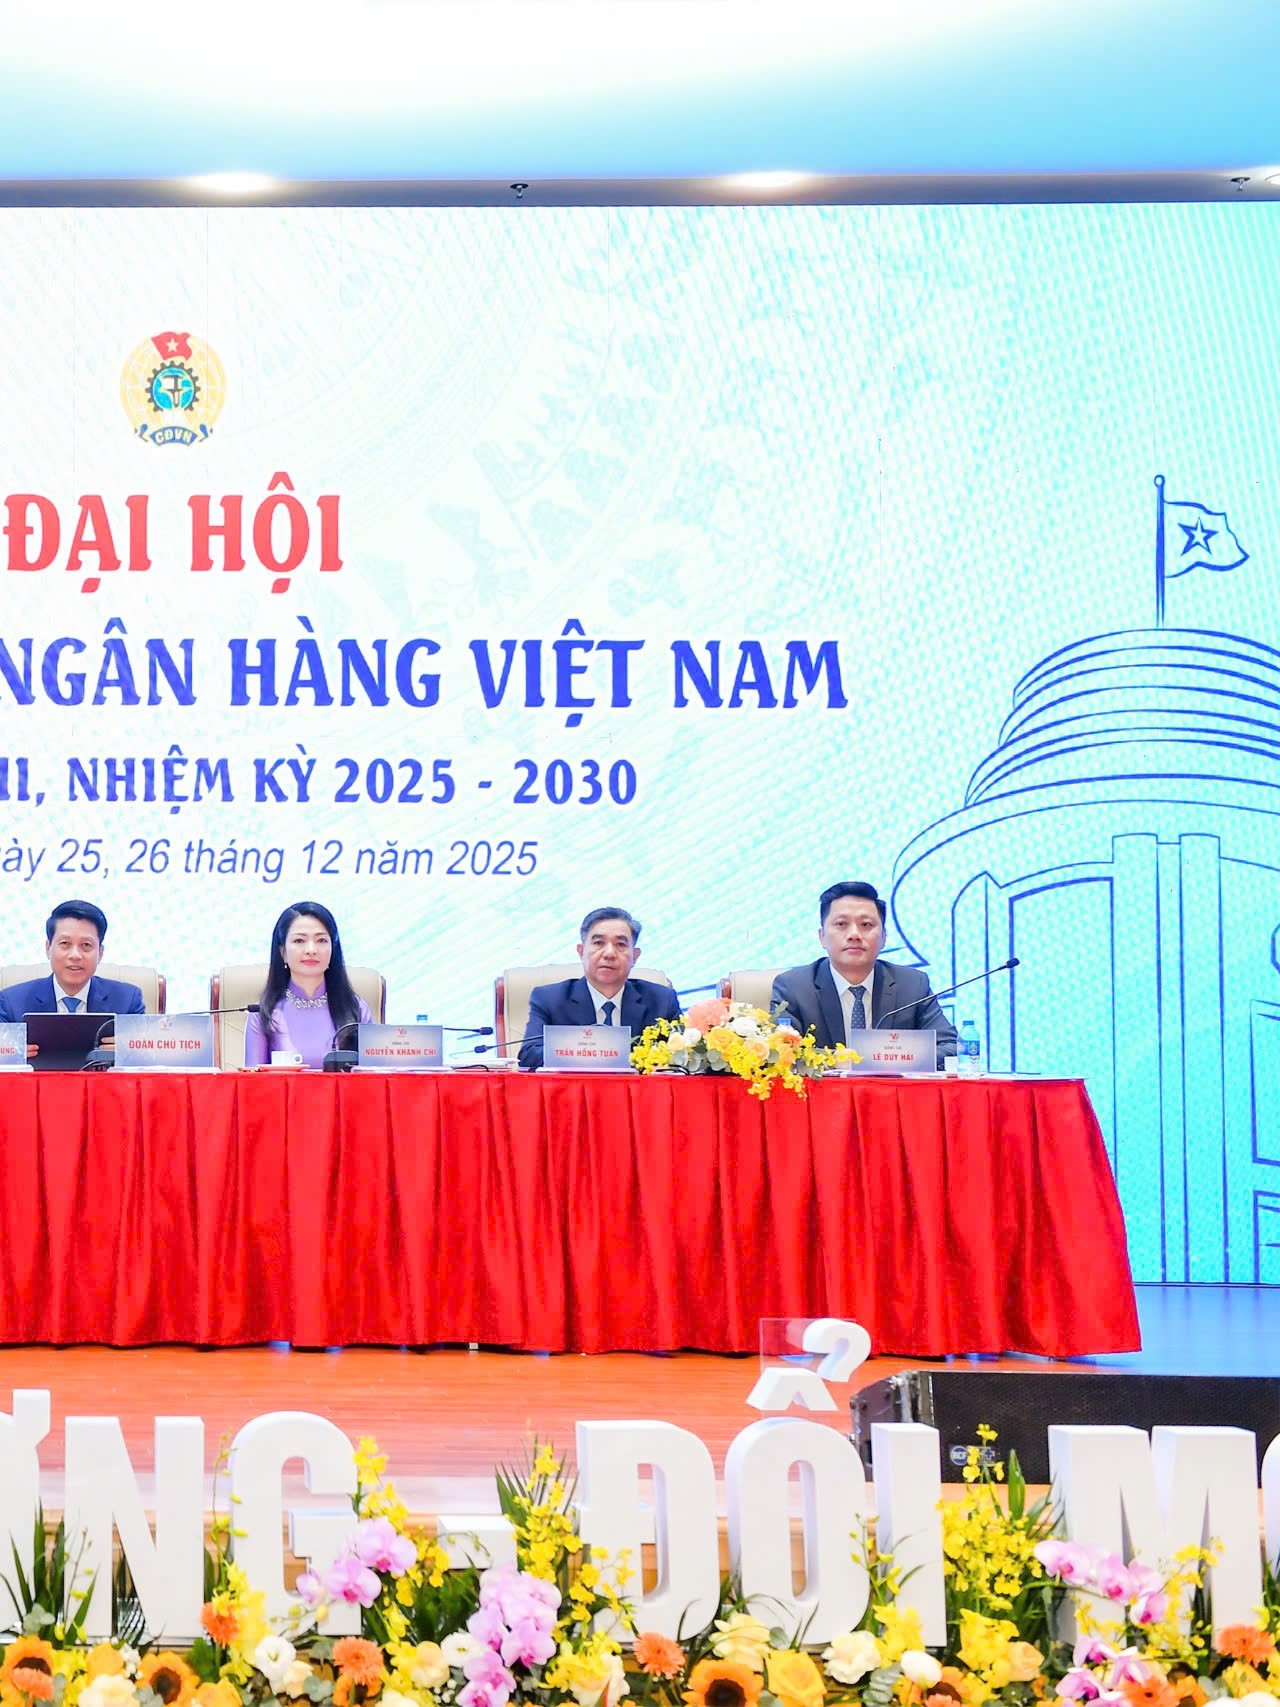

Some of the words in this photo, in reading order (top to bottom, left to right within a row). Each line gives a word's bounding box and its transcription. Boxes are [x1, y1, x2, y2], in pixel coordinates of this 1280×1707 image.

[3, 494, 151, 593] ĐẠI
[188, 472, 342, 594] HỘI
[228, 616, 440, 708] HÀNG
[469, 619, 645, 727] VIỆT
[670, 640, 848, 708] NAM
[67, 745, 234, 814] NHIỆM
[253, 744, 316, 802] KỲ
[335, 758, 455, 804] 2025
[514, 759, 636, 805] 2030
[58, 839, 109, 879] 25,
[126, 839, 170, 873] 26
[185, 839, 284, 882] tháng
[304, 840, 343, 873] 12
[356, 842, 432, 875] năm
[446, 841, 538, 875] 2025
[157, 1037, 176, 1049] CHỦ
[574, 1318, 948, 1648] ĐỔI
[1047, 1424, 1280, 1652] M
